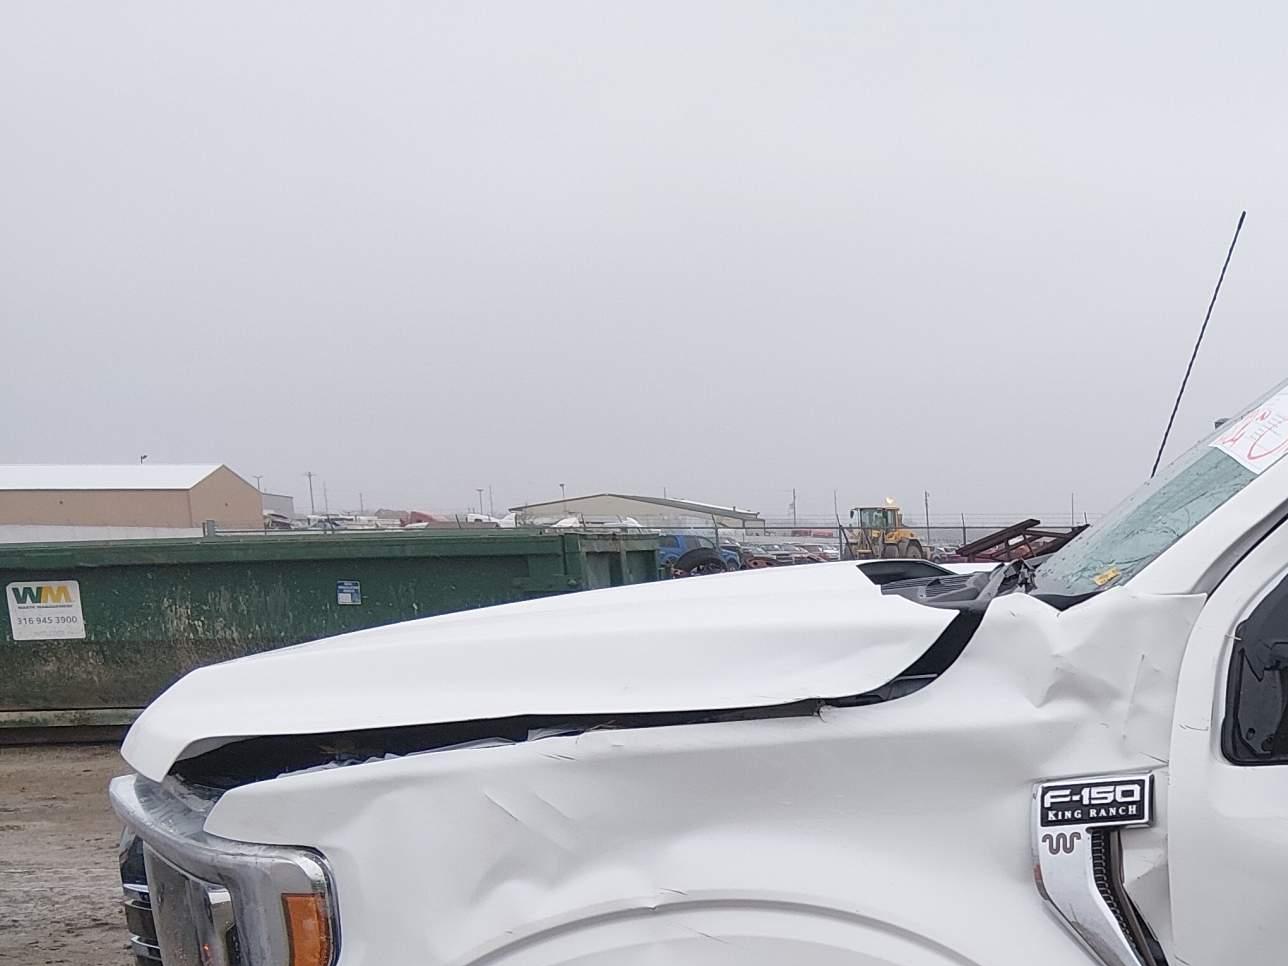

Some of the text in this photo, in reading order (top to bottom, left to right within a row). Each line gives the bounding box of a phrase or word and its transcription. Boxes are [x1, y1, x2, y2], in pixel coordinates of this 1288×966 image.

[12, 586, 73, 604] WM
[17, 617, 34, 625] 316
[36, 616, 53, 625] 945
[1044, 784, 1140, 807] F-150
[1047, 805, 1136, 821] KING RANCH
